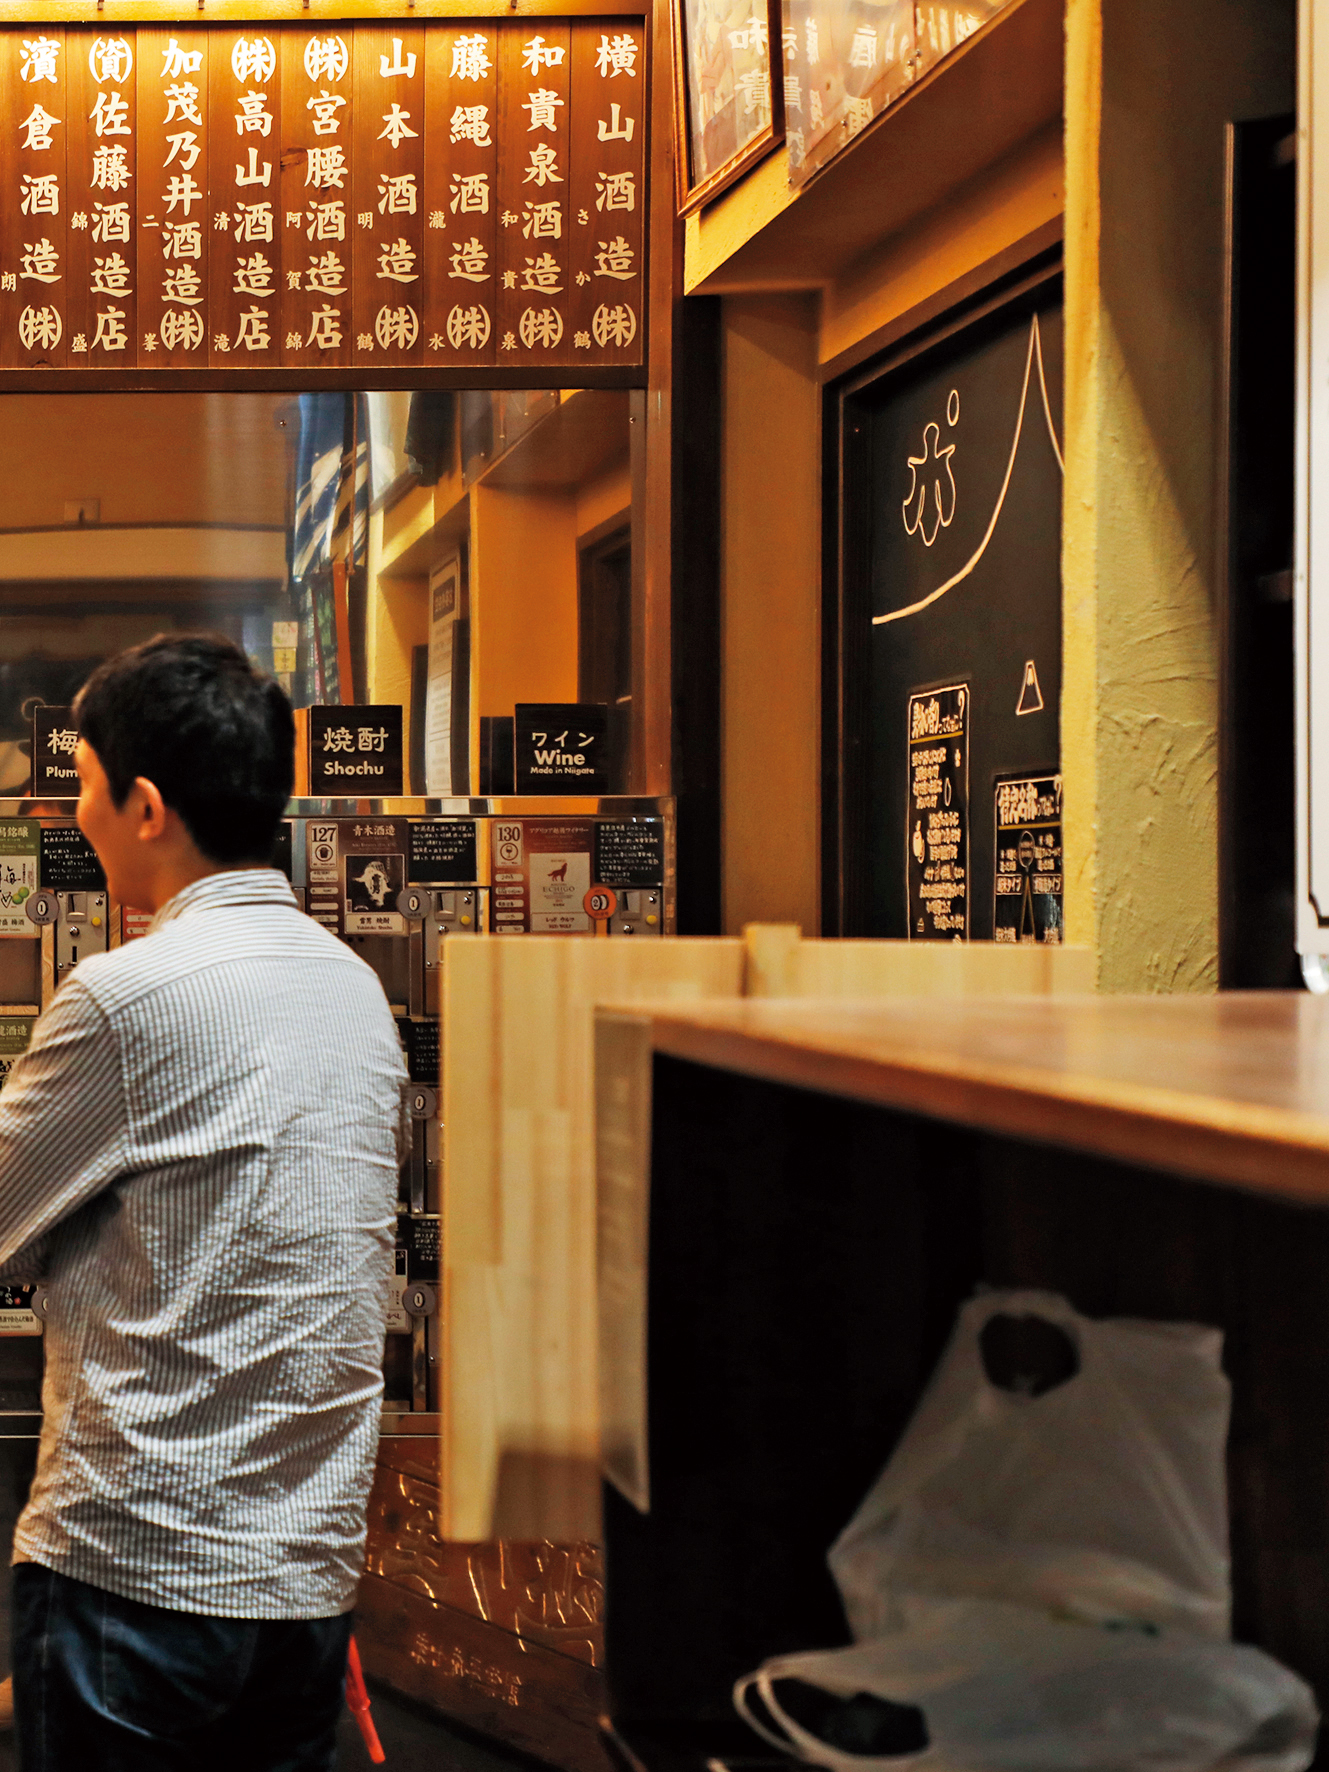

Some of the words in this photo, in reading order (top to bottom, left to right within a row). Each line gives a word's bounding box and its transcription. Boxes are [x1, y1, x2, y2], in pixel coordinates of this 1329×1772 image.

[1, 271, 17, 292] 朗
[71, 211, 89, 353] 錦盛
[213, 212, 231, 352] 清滝
[286, 211, 303, 351] 阿賀錦
[357, 210, 374, 352] 明鶴
[428, 209, 446, 351] 瀧水
[501, 209, 519, 351] 和貴泉
[574, 208, 592, 350] さか鶴
[323, 727, 389, 753] 焼酎
[531, 731, 595, 748] ワイン
[534, 749, 586, 766] Wine
[46, 766, 78, 778] Plum
[323, 761, 384, 776] Shochu
[530, 767, 552, 775] Made
[554, 767, 563, 775] in
[565, 767, 595, 776] Niigata
[311, 827, 337, 842] 127
[353, 824, 396, 836] 青木酒造
[497, 826, 521, 842] 130
